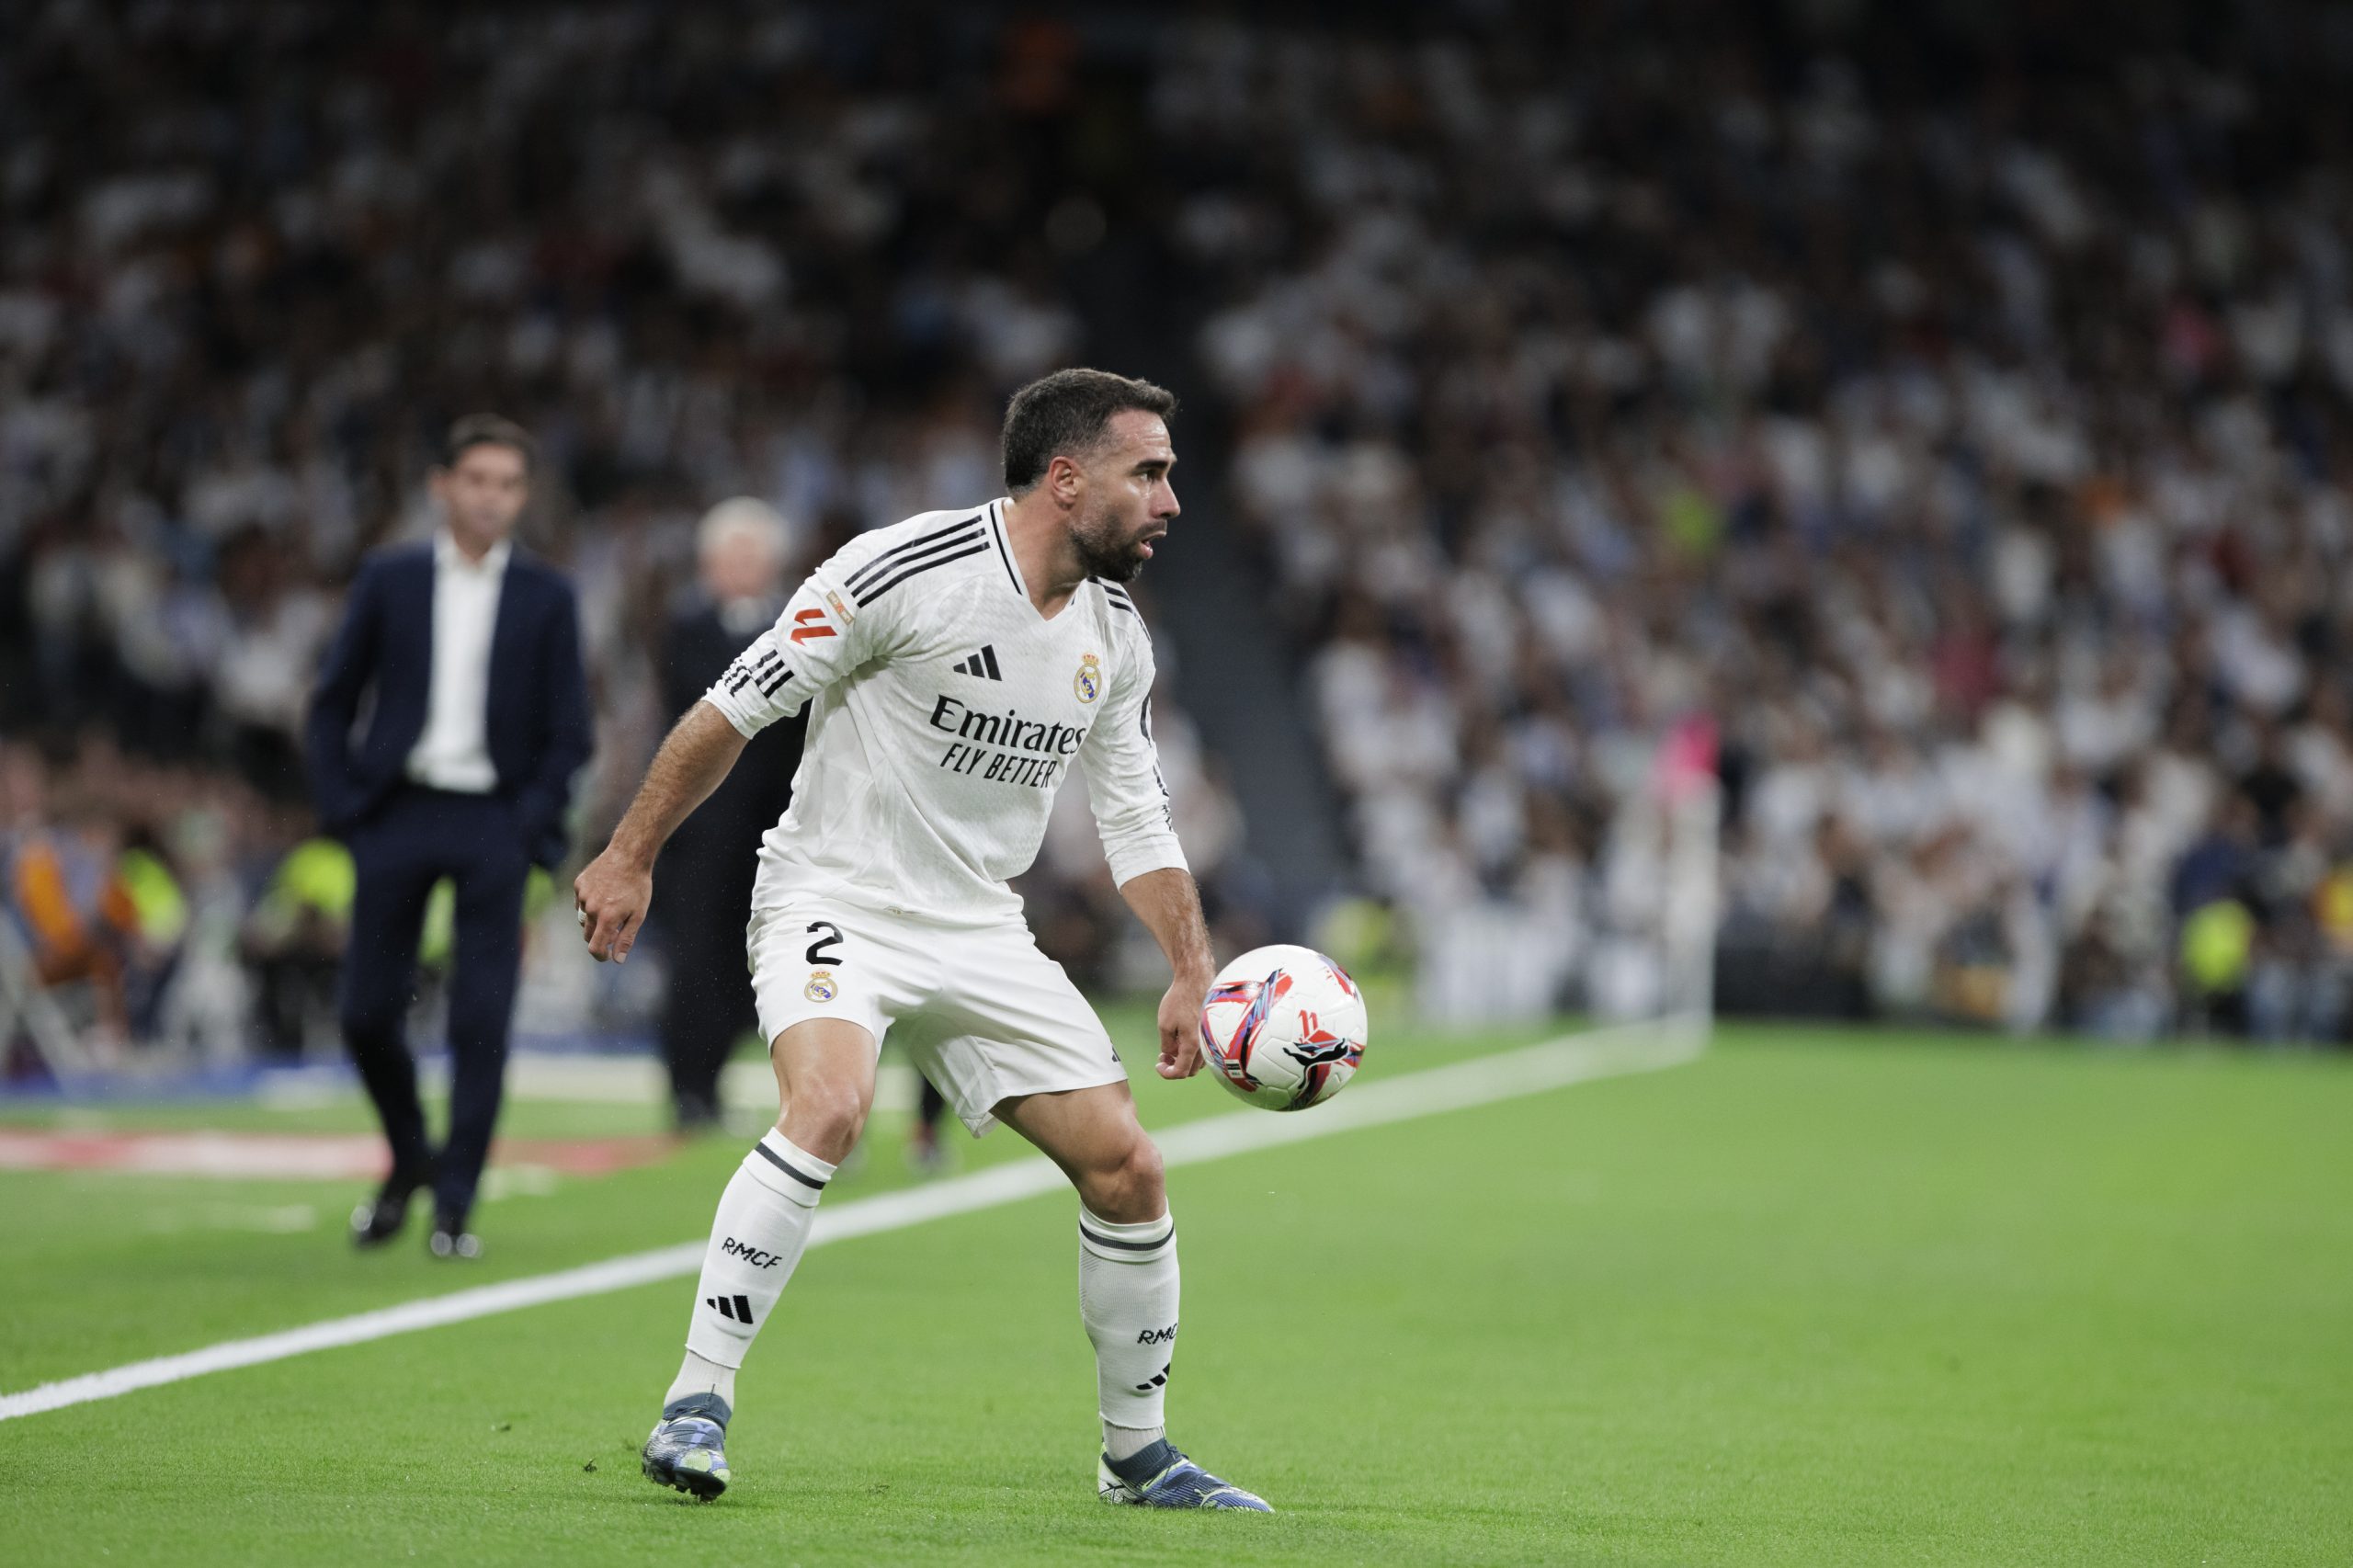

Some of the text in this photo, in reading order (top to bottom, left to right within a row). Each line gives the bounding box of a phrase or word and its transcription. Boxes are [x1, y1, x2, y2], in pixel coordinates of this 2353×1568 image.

[929, 694, 1086, 755] Emirates
[939, 743, 1059, 789] FLY BETTER
[805, 921, 844, 966] 2
[722, 1237, 783, 1269] RMCF
[1136, 1323, 1177, 1345] RMC
